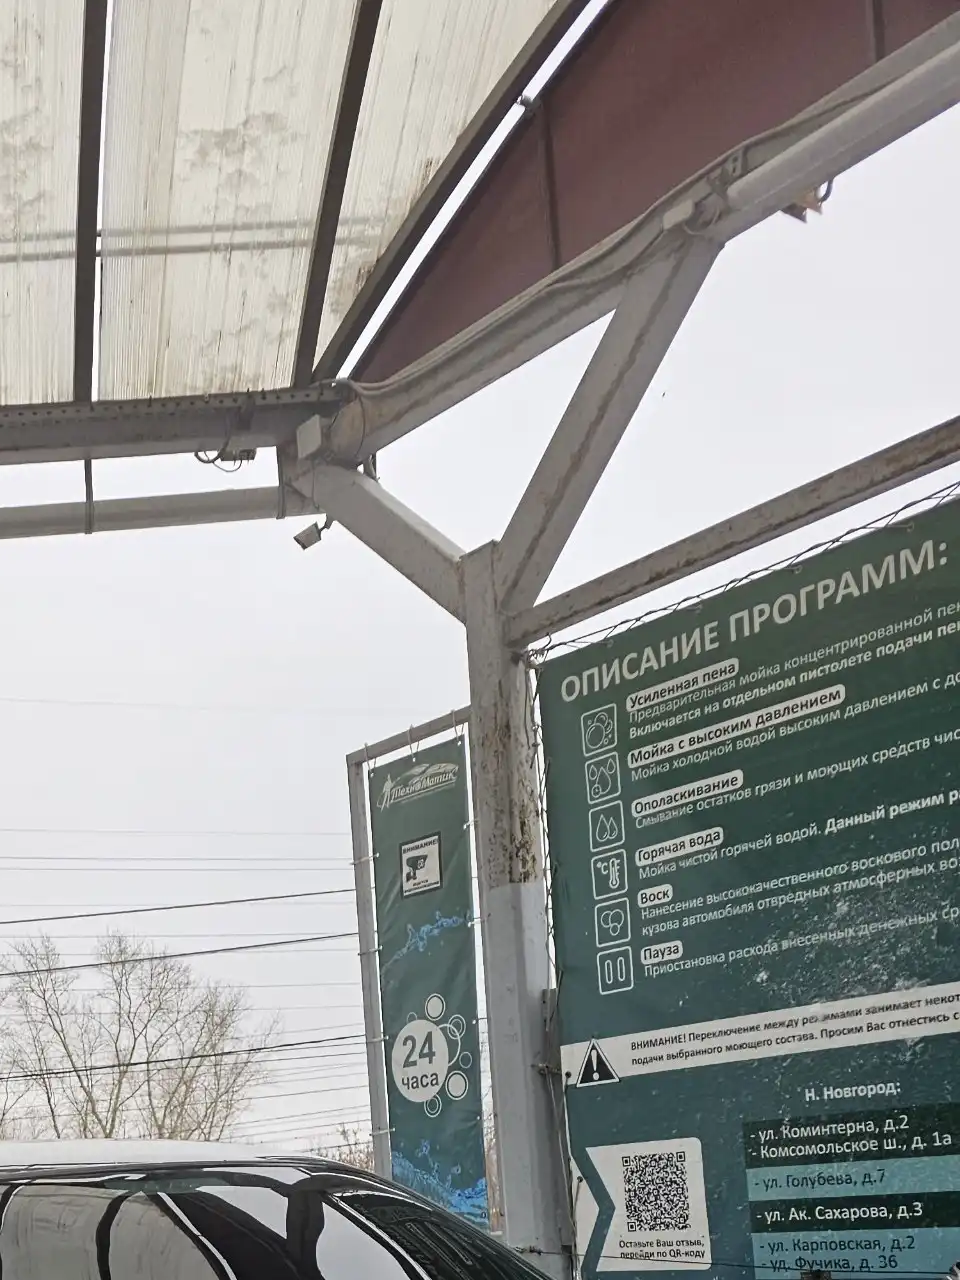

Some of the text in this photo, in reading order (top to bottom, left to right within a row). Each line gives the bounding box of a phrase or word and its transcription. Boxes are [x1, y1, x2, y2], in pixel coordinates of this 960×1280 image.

[560, 539, 948, 702] ОПИСАНИЕ ПРОГРАММ:
[629, 679, 736, 724] Предварительная
[739, 662, 780, 686] мойка
[784, 608, 933, 671] концентрированной
[629, 707, 701, 739] Включается
[704, 702, 720, 715] на
[722, 676, 796, 709] отдельном
[799, 650, 872, 683] пистолете
[876, 629, 933, 658] подачи
[629, 662, 736, 709] Усиленная пена
[630, 689, 841, 765] Мойка с высоким давлением
[631, 763, 670, 782] Мойка
[672, 739, 733, 770] холодной
[736, 727, 776, 750] водой
[779, 709, 841, 737] высоким
[843, 679, 929, 719] давлением
[932, 678, 940, 690] с
[634, 774, 739, 814] Ополаскивание
[635, 803, 694, 828] Смывание
[697, 786, 752, 811] остатков
[755, 776, 791, 797] грязи
[794, 774, 803, 784] и
[807, 754, 869, 781] моющих
[871, 737, 930, 764] средств
[637, 830, 721, 862] Горячая вода
[639, 864, 677, 880] Мойка
[679, 849, 718, 868] чистой
[720, 834, 772, 857] горячей
[775, 822, 822, 845] водой.
[824, 804, 885, 835] Данный
[889, 793, 945, 819] режим
[640, 889, 670, 905] Воск
[641, 896, 704, 920] Нанесение
[707, 861, 848, 903] высококачественного
[851, 845, 927, 871] воскового
[642, 918, 679, 937] кузова
[682, 902, 755, 927] автомобиля
[832, 863, 936, 893] атмосферных
[939, 857, 960, 871] во
[643, 944, 680, 961] Пауза
[644, 955, 725, 979] Приостановка
[728, 942, 778, 962] расхода
[631, 1033, 687, 1051] ВНИМАНИЕ!
[688, 1023, 761, 1043] Переключение
[763, 1016, 800, 1030] между
[864, 999, 922, 1016] занимает
[631, 1055, 664, 1066] подачи
[666, 1046, 723, 1061] выбранного
[725, 1038, 772, 1053] моющего
[775, 1031, 818, 1044] состава.
[820, 1025, 864, 1040] Просим
[866, 1021, 886, 1033] Вас
[889, 1013, 950, 1029] отнестись
[401, 1030, 436, 1069] 24
[401, 1072, 439, 1091] часа
[805, 1082, 901, 1102] Н. Новгород:
[758, 1130, 779, 1144] ул.
[782, 1119, 879, 1139] Коминтерна,
[883, 1114, 909, 1132] д.2
[760, 1136, 879, 1159] Комсомольское
[883, 1137, 907, 1151] ш.,
[911, 1136, 928, 1150] д.
[931, 1131, 953, 1146] 1а
[762, 1177, 782, 1192] ул.
[786, 1171, 858, 1190] Голубева,
[861, 1168, 886, 1186] д.7
[764, 1210, 785, 1225] ул.
[788, 1207, 812, 1221] Ак.
[815, 1205, 893, 1221] Сахарова,
[897, 1201, 923, 1219] д.3
[619, 1238, 705, 1249] Оставьте Ваш отзыв,
[668, 1248, 705, 1259] QR-коду
[768, 1242, 789, 1254] ул.
[792, 1237, 886, 1253] Карповская,
[890, 1235, 916, 1250] д.2
[795, 1256, 855, 1272] Фучика,
[859, 1258, 874, 1271] д.
[878, 1254, 898, 1269] 36
